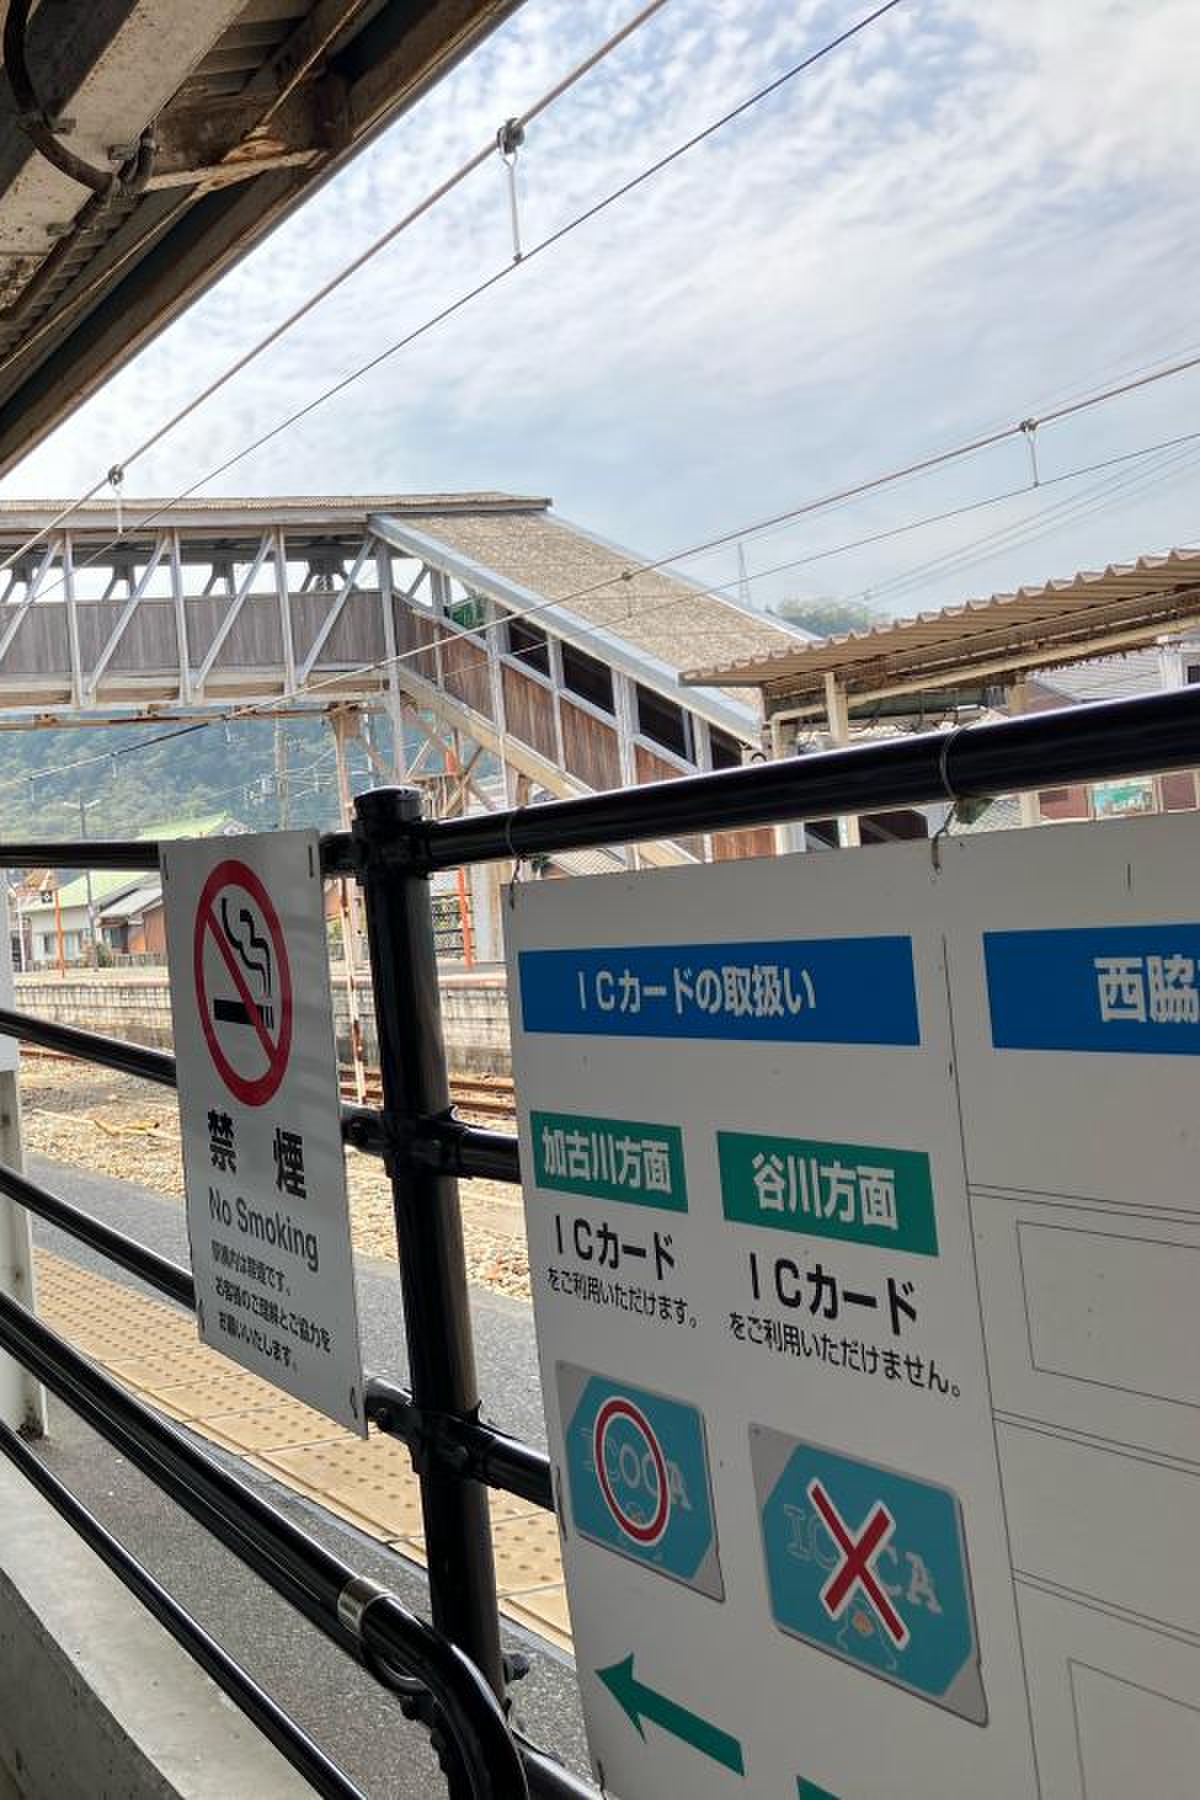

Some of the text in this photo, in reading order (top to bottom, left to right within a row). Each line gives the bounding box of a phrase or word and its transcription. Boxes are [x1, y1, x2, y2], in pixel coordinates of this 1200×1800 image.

[577, 964, 817, 1017] ICカードの取扱い
[541, 1125, 673, 1195] 加古川方面
[751, 1151, 900, 1231] 谷川方面
[208, 1186, 319, 1273] No Smoking
[555, 1214, 676, 1281] ICカード
[547, 1266, 698, 1329] をご利用いただけます。
[749, 1252, 918, 1336] ICカード
[729, 1311, 962, 1398] をご利用いただけません。
